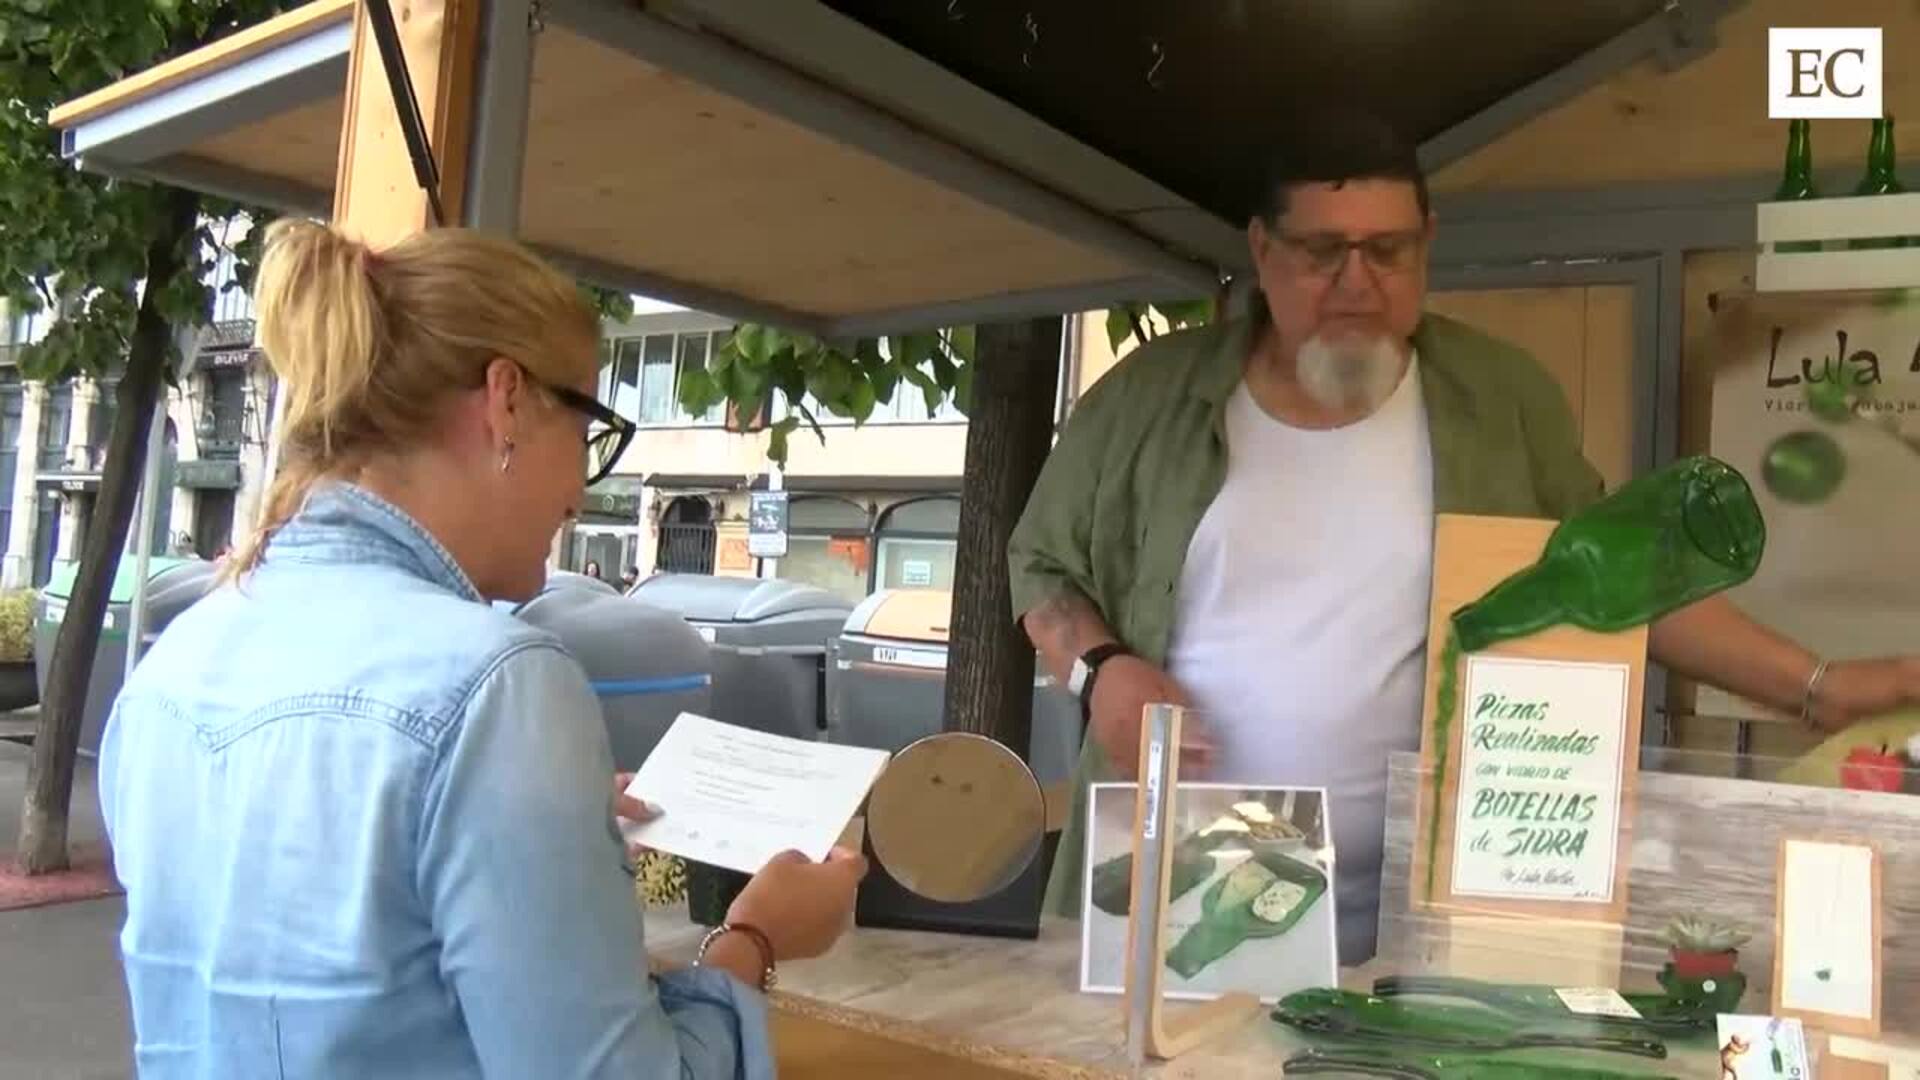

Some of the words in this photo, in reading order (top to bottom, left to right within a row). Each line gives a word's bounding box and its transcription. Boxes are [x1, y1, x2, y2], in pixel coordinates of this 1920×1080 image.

[1765, 326, 1882, 389] Lula
[1475, 692, 1549, 721] Piezas
[1472, 723, 1600, 755] Realizadas
[1473, 788, 1597, 822] BOTELLAS
[1504, 828, 1588, 858] SIDRA
